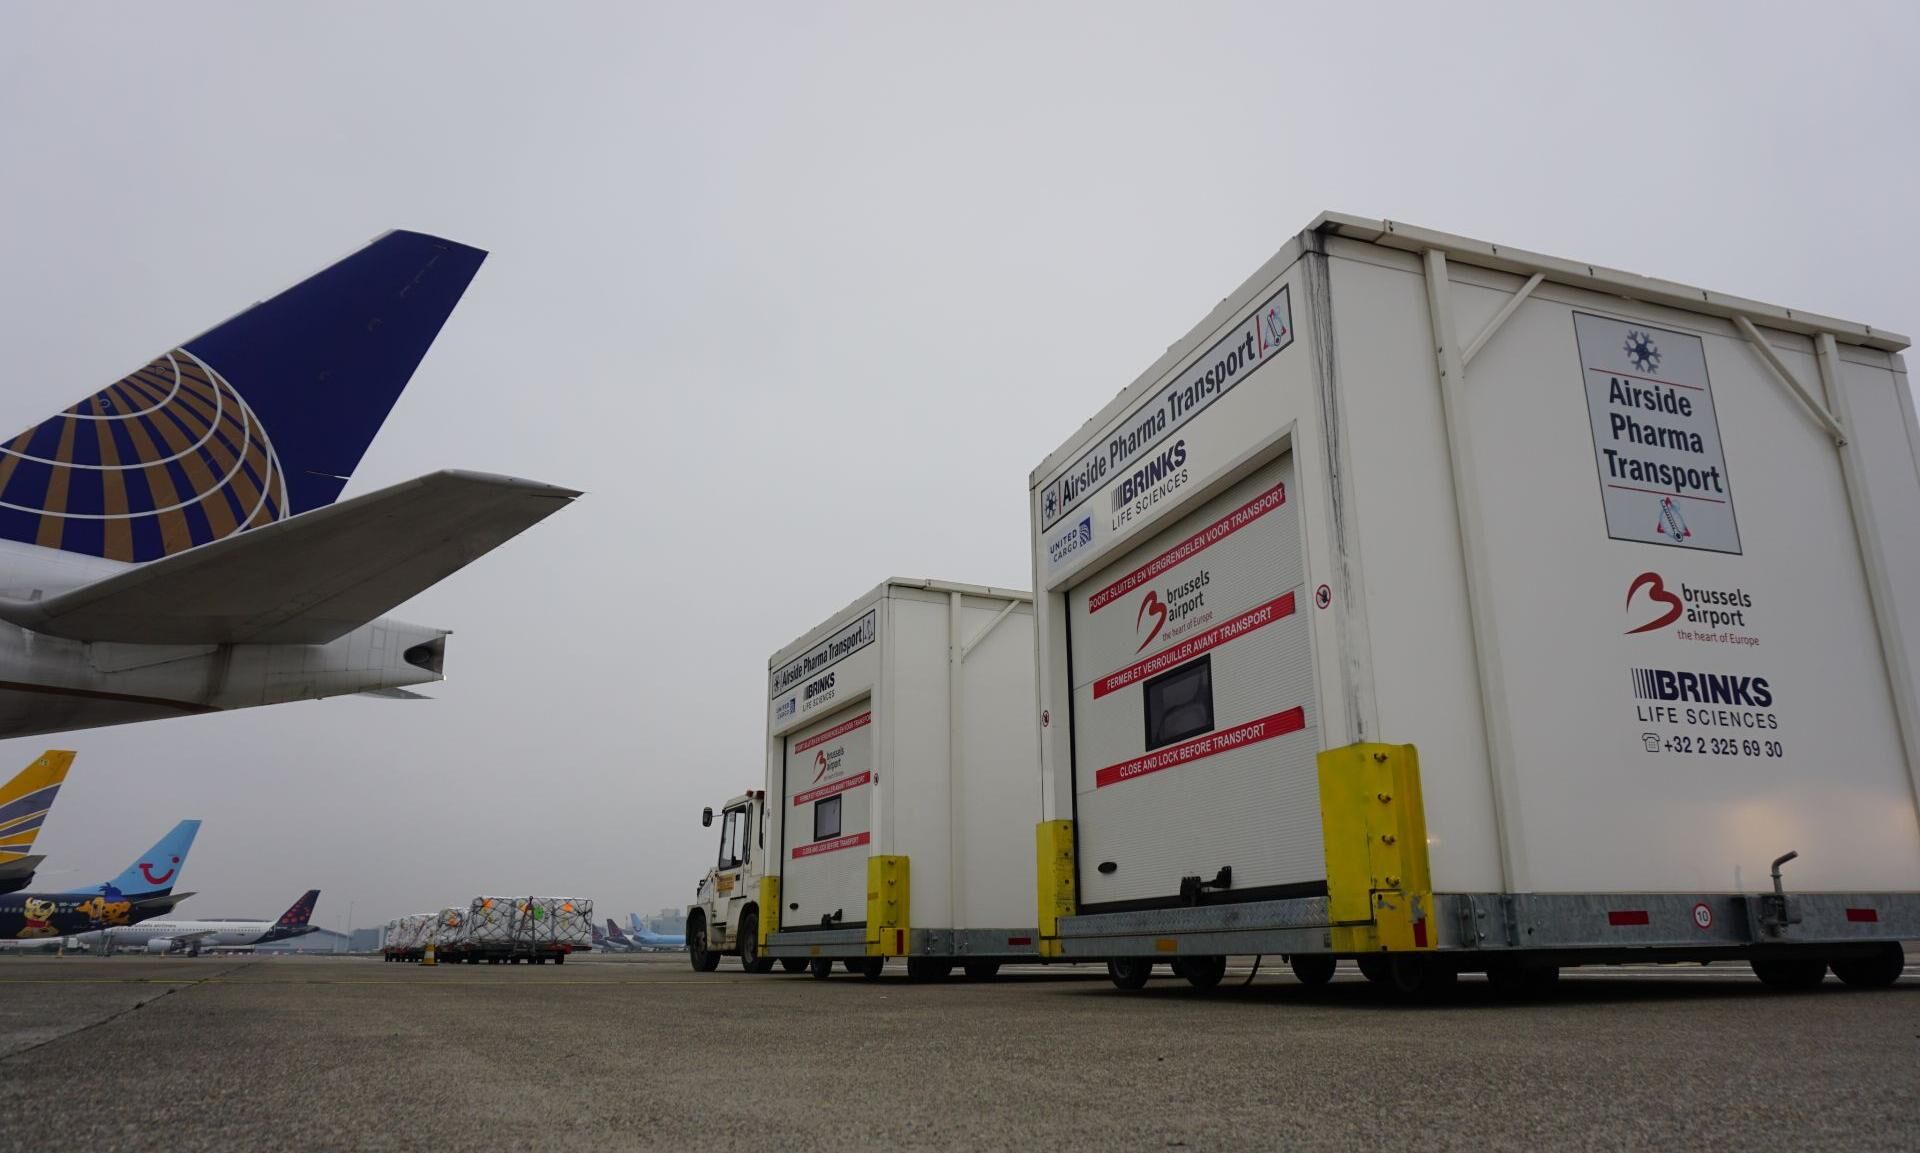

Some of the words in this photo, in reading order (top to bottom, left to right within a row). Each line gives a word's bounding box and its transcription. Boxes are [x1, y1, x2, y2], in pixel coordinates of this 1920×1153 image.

[1609, 376, 1693, 417] Airside
[1062, 456, 1107, 507] Airside
[1110, 405, 1166, 469] Pharma
[1168, 330, 1256, 422] Transport
[1609, 412, 1705, 454] Pharma
[1120, 439, 1187, 507] BRINKS
[1603, 448, 1724, 494] Transport
[1112, 508, 1132, 531] LIFE
[1136, 469, 1188, 515] SCIENCES
[1050, 529, 1078, 554] UNITED
[1053, 541, 1078, 562] CARGO
[1110, 576, 1137, 598] SLUITEN
[1137, 571, 1147, 583] EN
[1147, 534, 1206, 576] VERGRENDELEN
[1206, 521, 1230, 542] VOOR
[1230, 487, 1283, 528] TRANSPORT
[1167, 570, 1210, 604] brussels
[1681, 582, 1752, 608] brussels
[1169, 591, 1204, 622] airport
[1687, 604, 1745, 628] airport
[782, 664, 802, 685] Airside
[804, 649, 828, 675] Pharma
[829, 626, 862, 659] Transport
[1107, 670, 1132, 690] FERMER
[1133, 666, 1142, 678] ET
[1143, 643, 1192, 675] VERROUILLER
[1193, 631, 1219, 652] AVANT
[1220, 606, 1272, 640] TRANSPORT
[1677, 630, 1693, 641] the
[1694, 631, 1718, 642] heart
[1720, 633, 1729, 643] of
[1729, 633, 1760, 647] Europe
[807, 672, 835, 699] BRINKS
[1653, 668, 1773, 708] BRINKS
[1637, 705, 1679, 724] LIFE
[1686, 708, 1778, 730] SCIENCES
[1120, 761, 1142, 777] CLOSE
[1143, 757, 1157, 771] AND
[1158, 750, 1179, 766] LOCK
[1180, 741, 1211, 760] BEFORE
[1213, 723, 1265, 748] TRANSPORT
[1664, 736, 1692, 753] +32
[1697, 737, 1707, 754] 2
[1711, 738, 1738, 756] 325
[1743, 740, 1761, 757] 69
[1765, 741, 1783, 758] 30
[1697, 910, 1708, 922] 10
